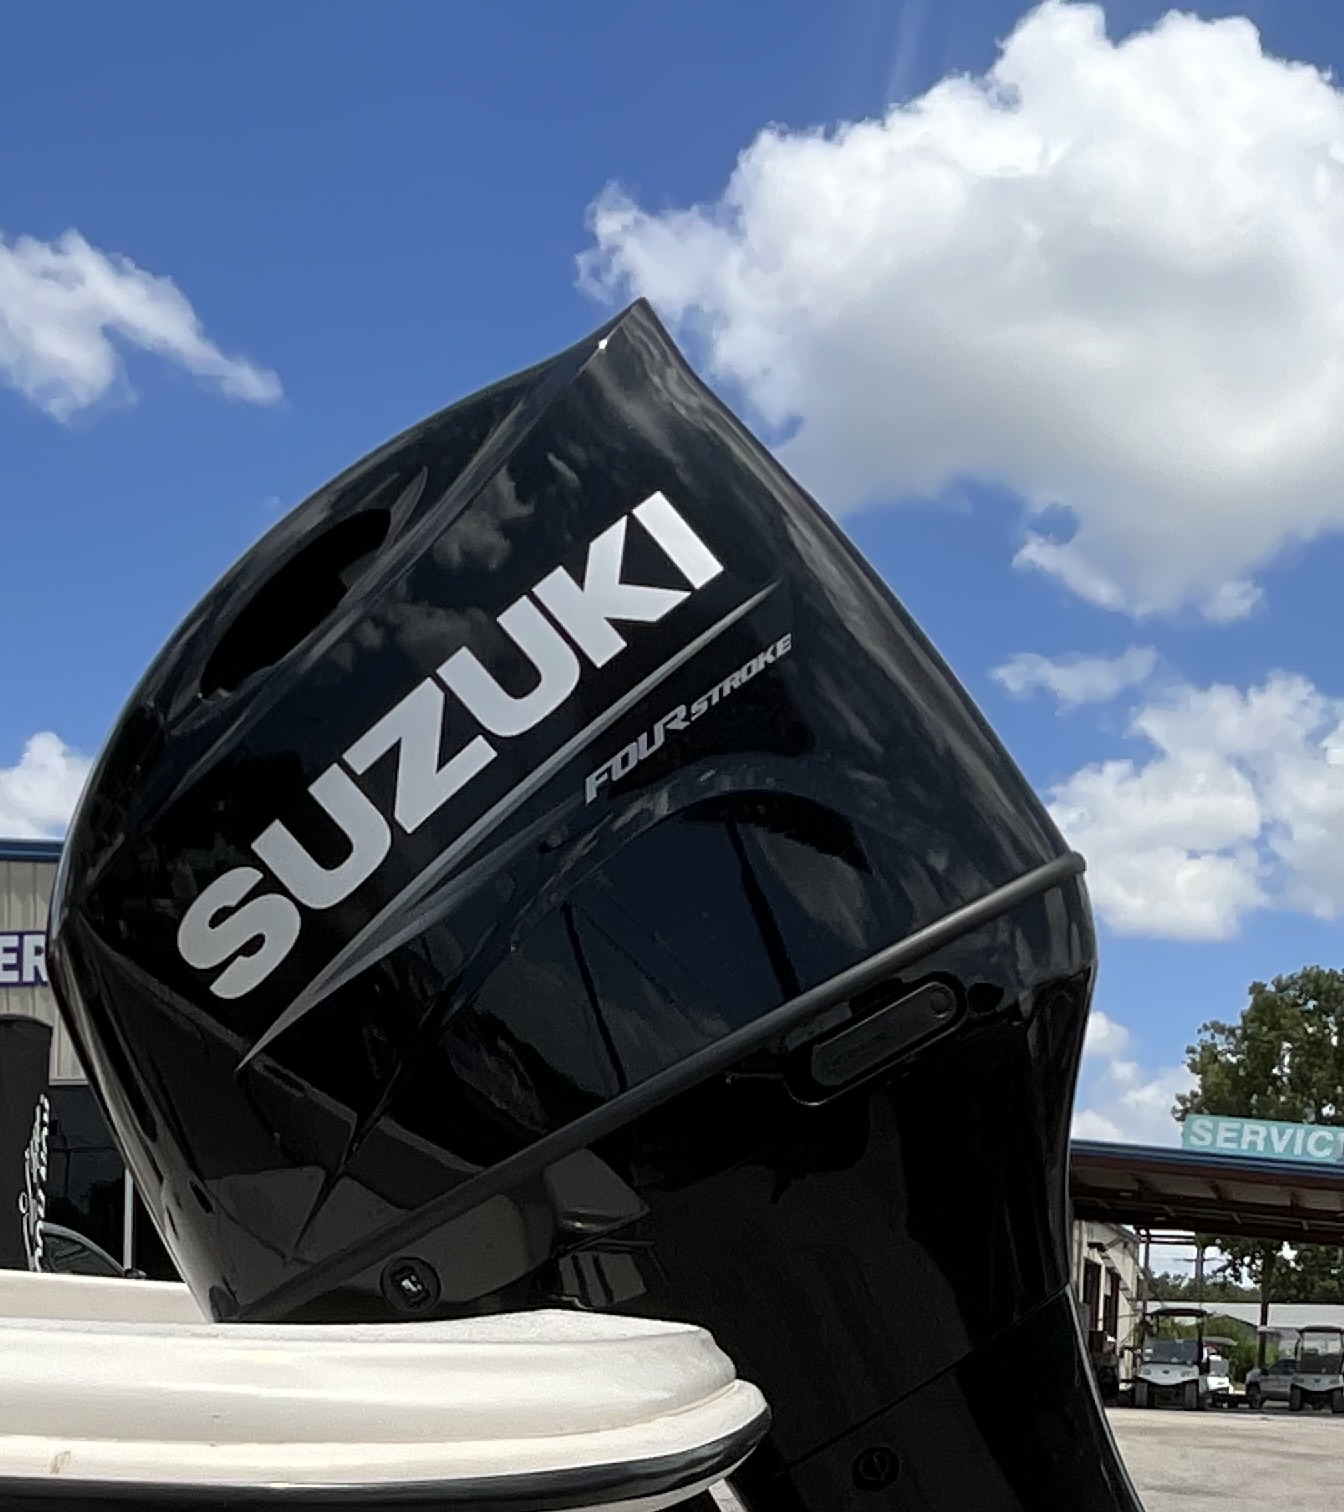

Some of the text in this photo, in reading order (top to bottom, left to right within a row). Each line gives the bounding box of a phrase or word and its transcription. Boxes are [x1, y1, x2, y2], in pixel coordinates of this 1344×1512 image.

[176, 489, 725, 1001] SUZUKI
[584, 632, 790, 807] FOUR STROKE
